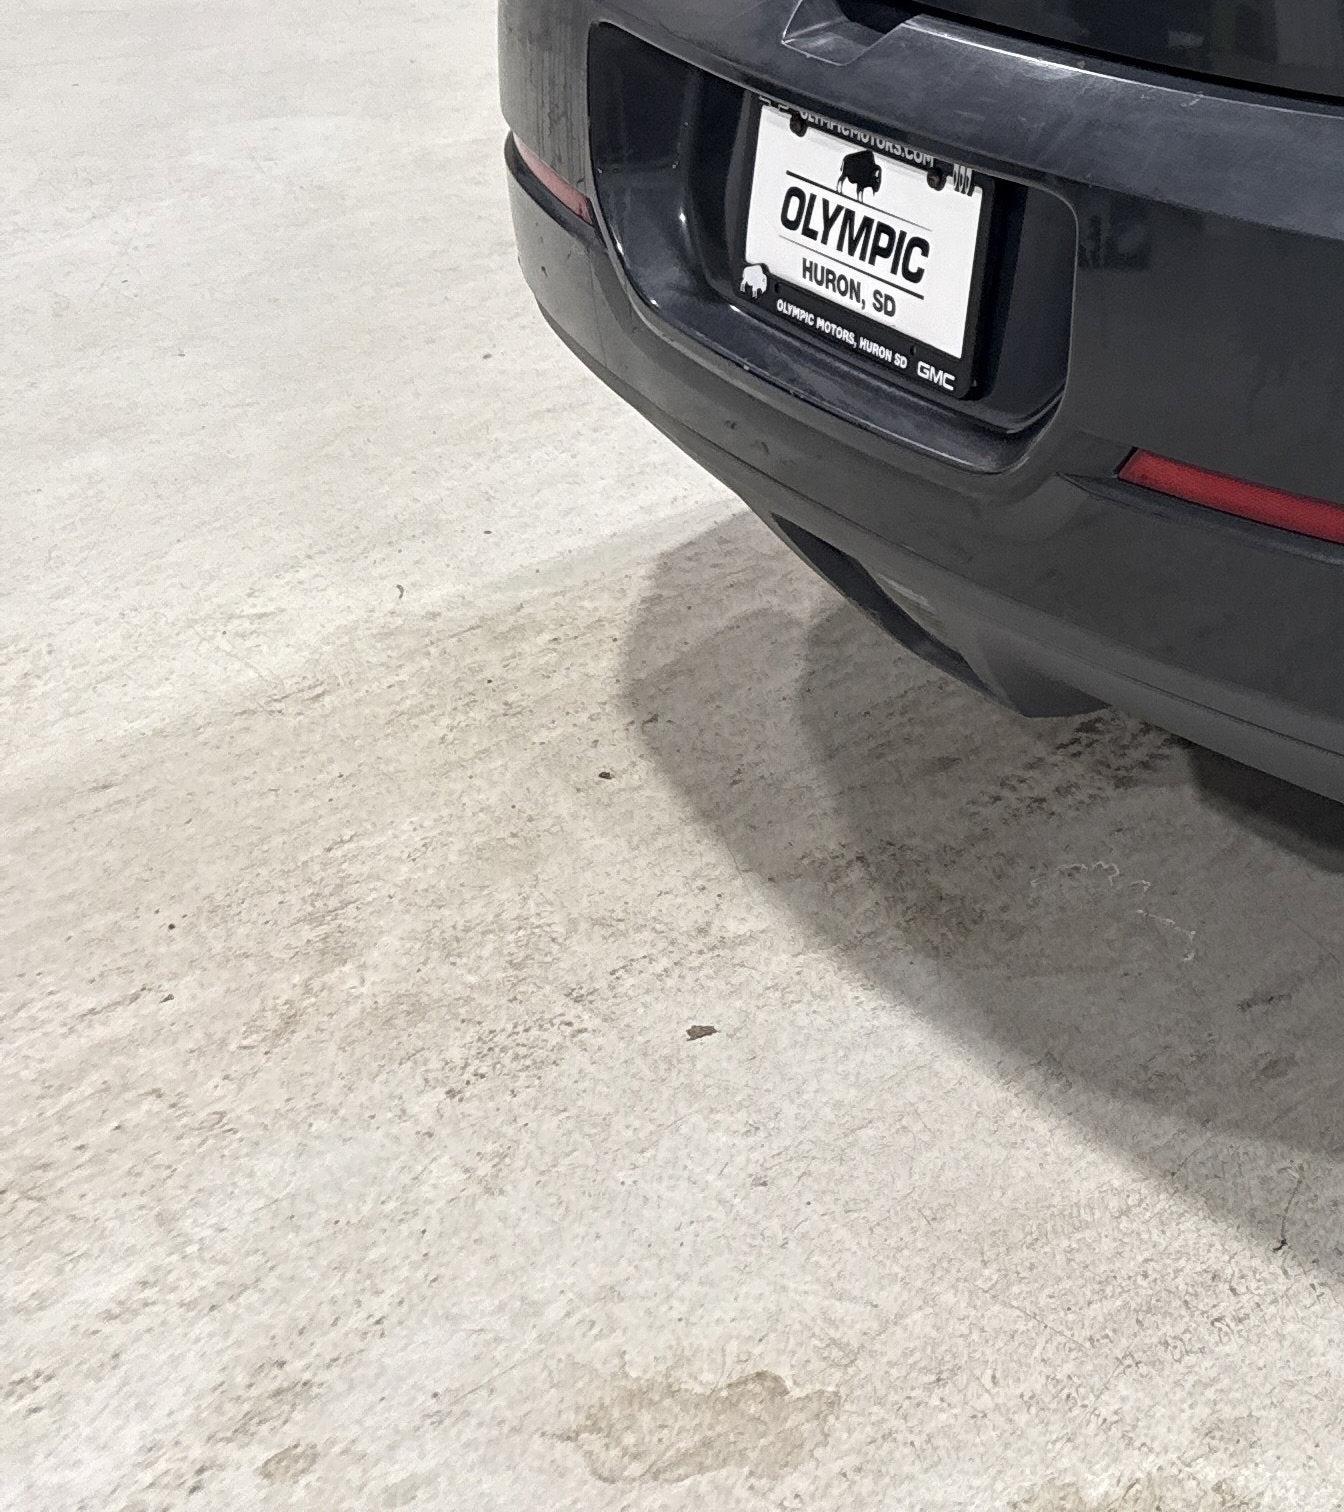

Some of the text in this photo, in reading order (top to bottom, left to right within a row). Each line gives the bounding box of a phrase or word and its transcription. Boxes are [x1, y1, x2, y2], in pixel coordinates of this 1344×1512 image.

[780, 186, 930, 285] OLYMPIC
[802, 257, 897, 318] HURON, SD
[776, 299, 956, 391] OLYMPIC MOTORS, HURON SD GMC
